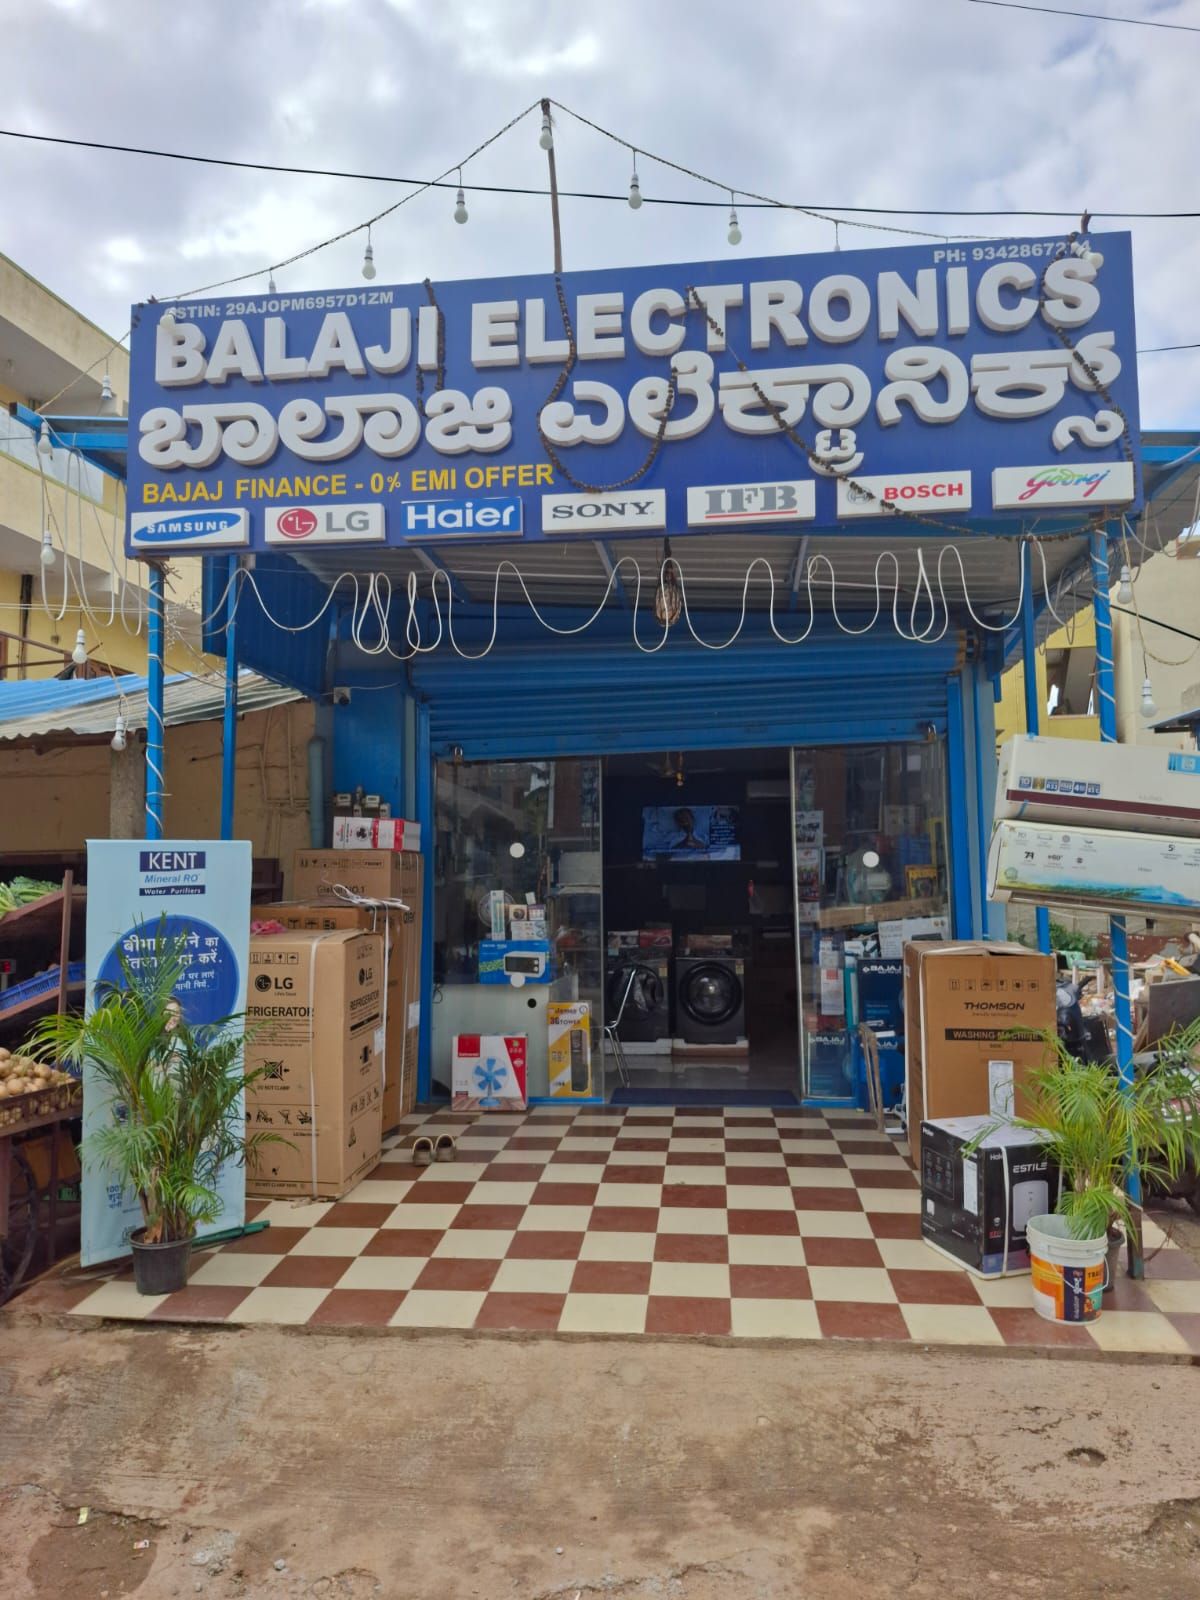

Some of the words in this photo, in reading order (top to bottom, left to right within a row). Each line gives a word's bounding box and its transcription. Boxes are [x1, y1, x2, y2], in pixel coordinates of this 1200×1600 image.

[933, 249, 967, 263] PH:
[972, 240, 1091, 261] 934286724
[225, 291, 394, 316] 29AJOPM6957D1ZM
[155, 305, 438, 387] BALAJI
[470, 258, 1101, 369] ELECTRONICS
[138, 386, 513, 470] ಬಾಲಾಜಿ
[143, 481, 224, 504] BAJAJ
[235, 474, 347, 500] FINANCE
[370, 472, 402, 494] 0%
[411, 469, 457, 491] EMI
[464, 463, 554, 490] OFFER
[884, 483, 963, 500] BOSCH
[705, 485, 798, 514] IFB
[407, 501, 514, 531] Haier
[552, 501, 654, 519] SONY
[146, 520, 229, 534] SAMSUNG
[325, 510, 370, 533] LG
[148, 852, 198, 870] KENT
[144, 874, 181, 884] Mineral
[183, 873, 199, 883] RO
[144, 888, 166, 896] Water
[170, 886, 201, 895] Purifiers
[204, 936, 220, 948] का
[365, 967, 373, 980] LG
[274, 977, 293, 989] LG
[963, 1001, 1025, 1011] THOMSON
[953, 1031, 996, 1039] WASHING
[1012, 1162, 1048, 1174] ESTILE
